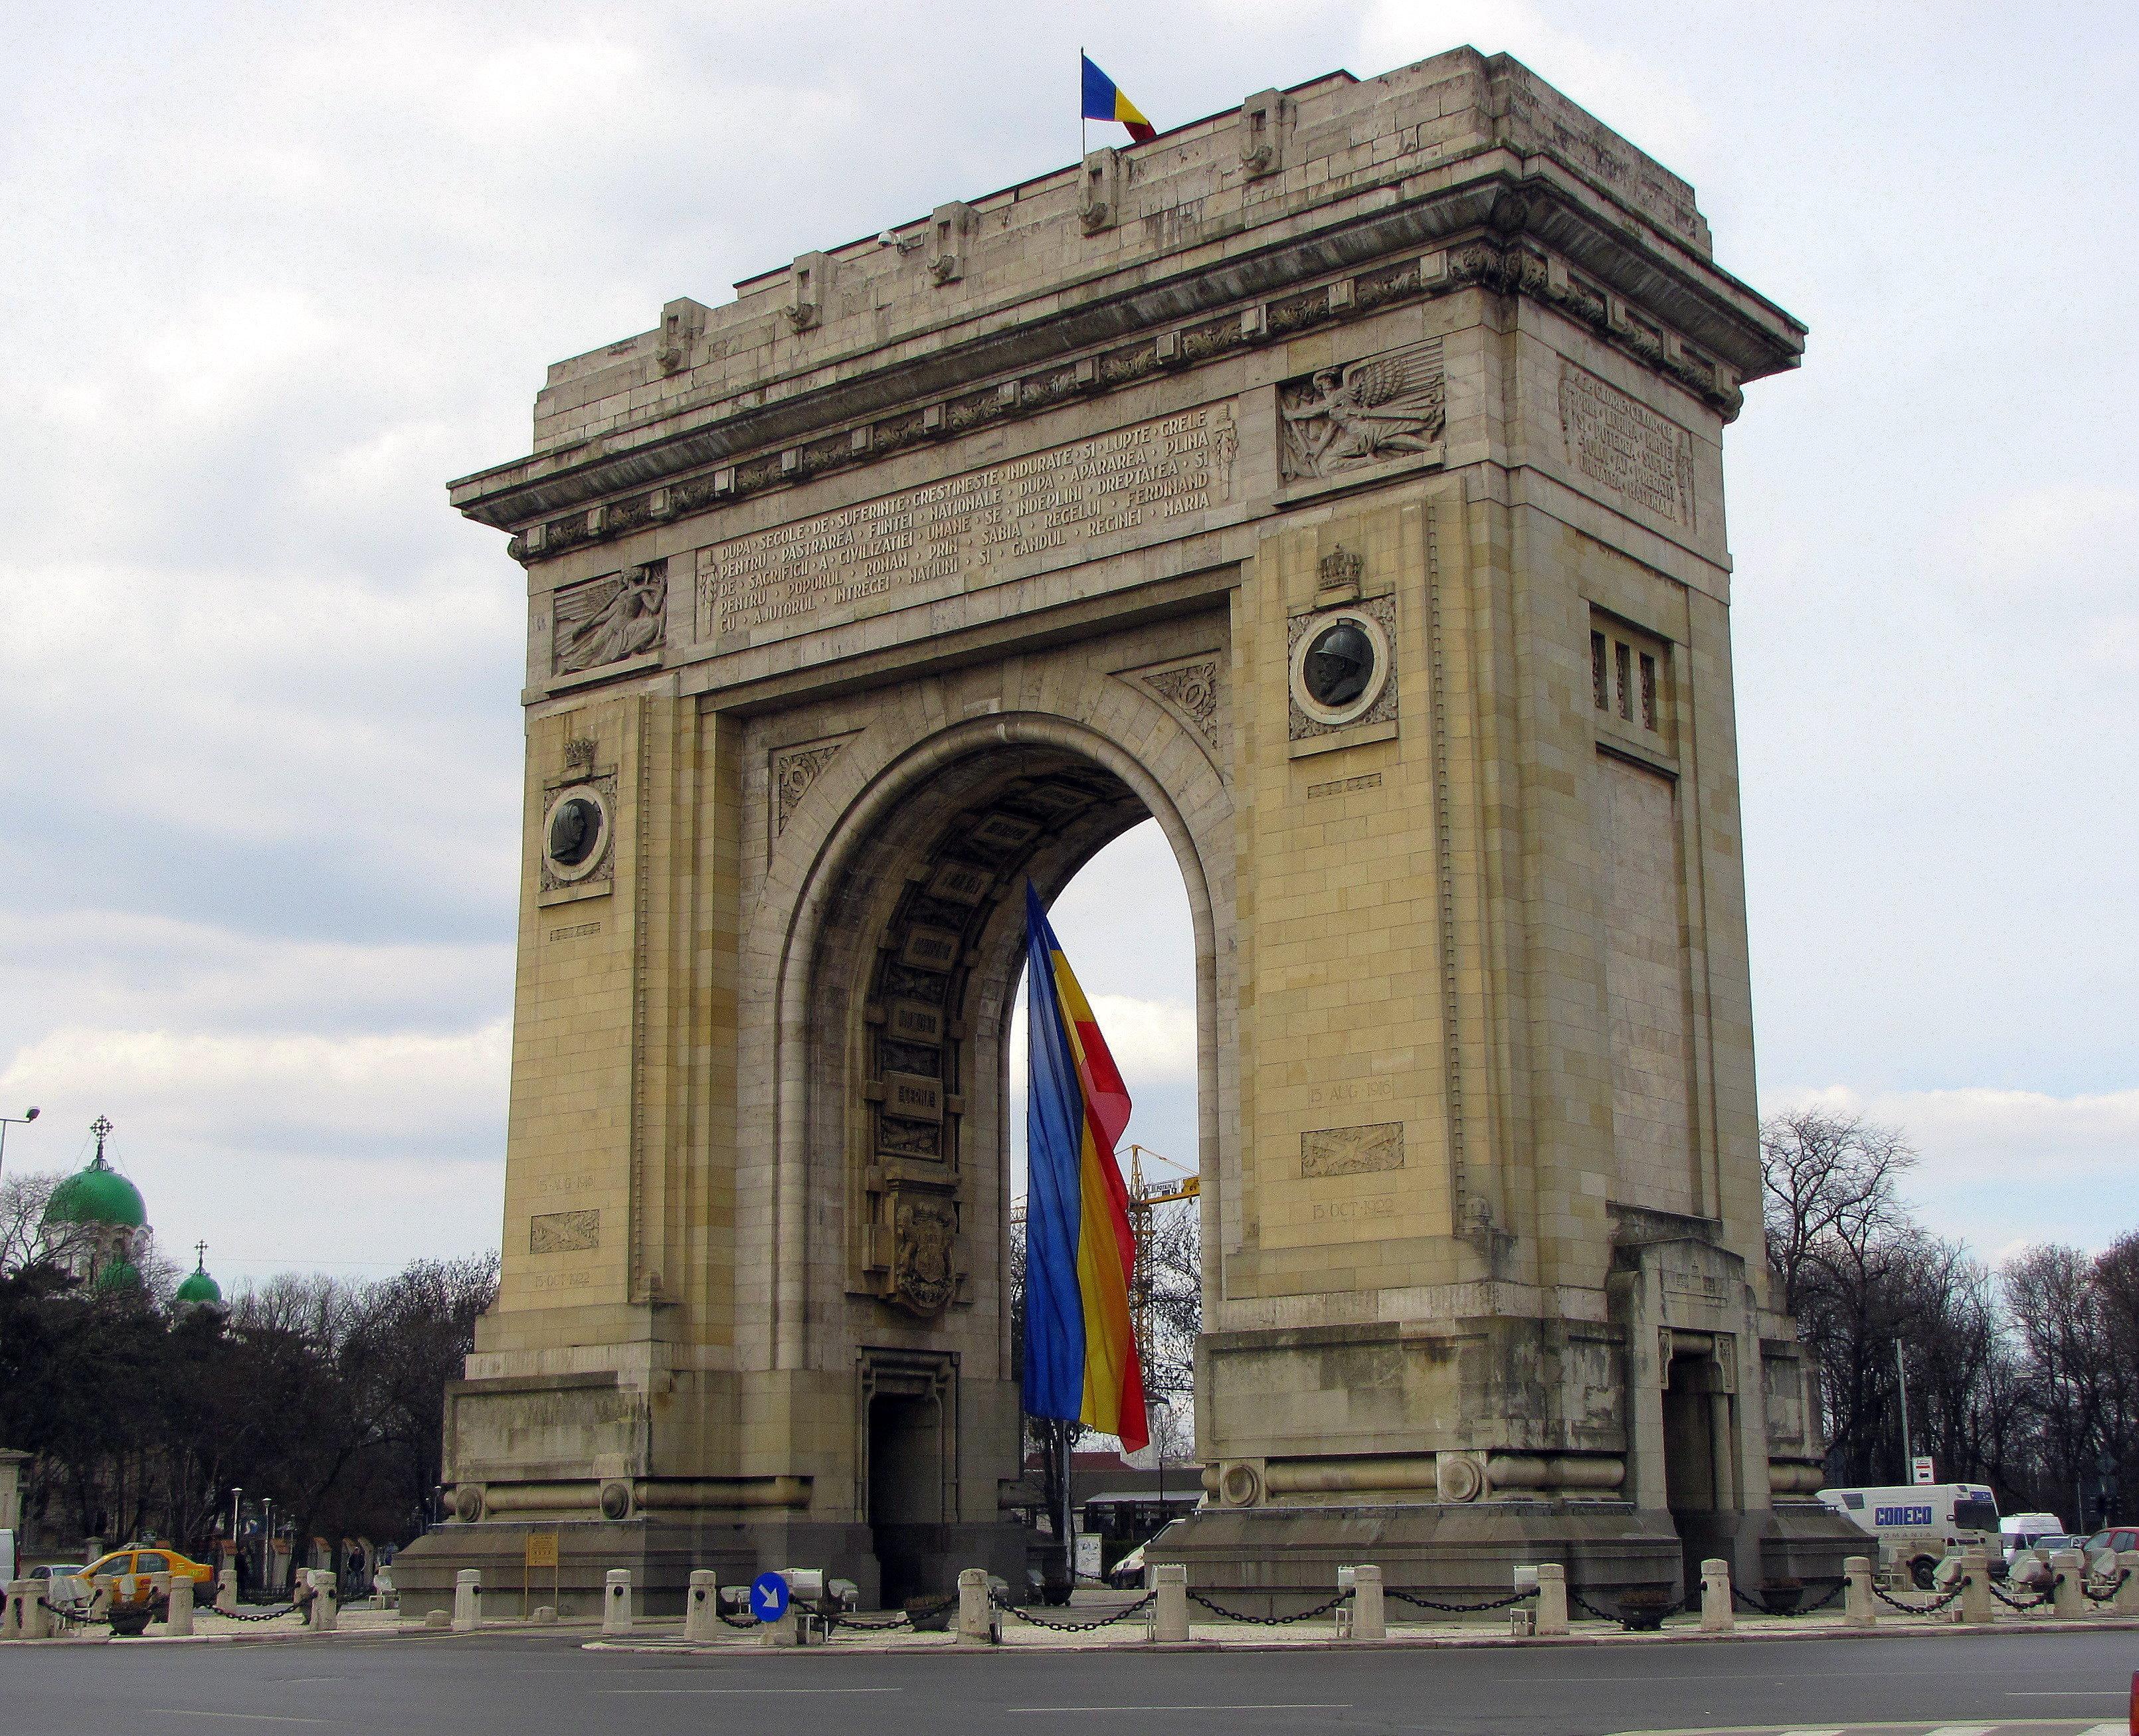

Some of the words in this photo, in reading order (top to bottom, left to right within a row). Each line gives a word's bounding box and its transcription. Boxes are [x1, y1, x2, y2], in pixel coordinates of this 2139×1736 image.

[721, 553, 767, 579] PENTRU
[782, 531, 854, 563] PASTRAREA
[870, 513, 913, 539] FIINTEI
[930, 490, 1002, 522] NATIONALE
[1019, 474, 1054, 497] DUPA
[1070, 448, 1145, 483] APARAREA
[1165, 431, 1208, 456] PLINA
[721, 582, 735, 597] DE
[749, 559, 808, 589] SACRIFICII
[819, 554, 828, 570] A
[840, 531, 913, 565] CIVILIZATIEI
[927, 518, 970, 540] UMANE
[985, 508, 1002, 526] SE
[1018, 485, 1082, 517] INDEPLINI
[1097, 460, 1178, 495] DREPTATEA
[1194, 451, 1208, 468] SI
[721, 590, 767, 616] PENTRU
[788, 571, 842, 599] POPORUL
[865, 552, 908, 578] ROMAN
[929, 538, 958, 559] PRIN
[981, 523, 1022, 546] SABIA
[1045, 500, 1102, 529] REGELUI
[1127, 473, 1208, 507] FERDINAND
[722, 539, 753, 562] DUPA
[759, 525, 804, 551] SECOLE
[814, 519, 829, 533] DE
[837, 496, 905, 527] SUFERINTE
[913, 470, 998, 506] CRESTINESTE
[1008, 450, 1072, 482] INDURATE
[1080, 443, 1095, 460] SI
[1105, 426, 1150, 454] LUPTE
[1161, 410, 1207, 436] GRELE
[721, 616, 736, 632] CU
[753, 596, 816, 625] AJUTORUL
[908, 559, 958, 585] NATIUNI
[978, 549, 991, 567] SI
[1164, 492, 1210, 518] MARIA
[1875, 1506, 1932, 1525] CONECO
